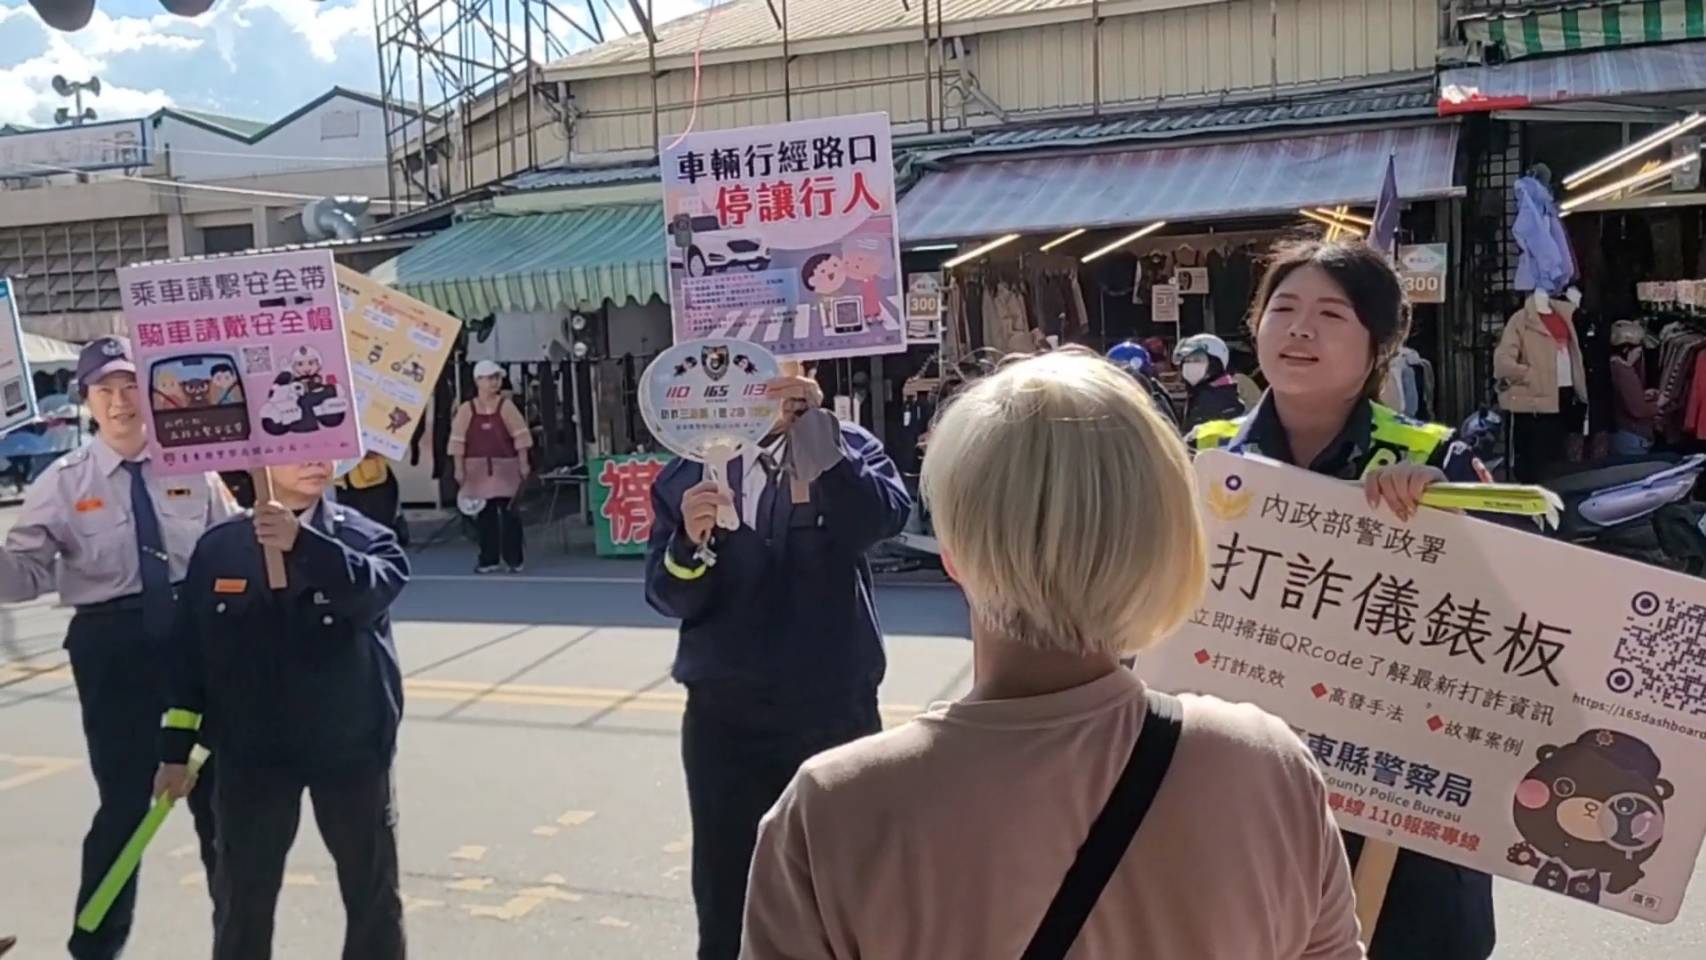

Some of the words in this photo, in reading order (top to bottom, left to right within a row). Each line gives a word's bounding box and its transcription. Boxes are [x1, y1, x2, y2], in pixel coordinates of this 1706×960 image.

[677, 134, 877, 184] 車輛行經路口
[715, 172, 881, 226] 停讓行人
[130, 265, 326, 308] 乘車請繫安全帶
[911, 297, 937, 312] 300
[137, 307, 334, 348] 騎車請戴安全帽
[666, 386, 691, 399] 110
[703, 384, 730, 398] 165
[743, 383, 768, 396] 113
[1260, 493, 1447, 565] 內政部警政署
[1210, 531, 1572, 687] 打詐儀錶板
[1188, 607, 1555, 727] 立即掃描QRcode了解最新打詐資訊
[1211, 652, 1286, 689] 打詐成效
[1328, 686, 1404, 723] 高發手法
[1445, 720, 1524, 757] 故事案例
[1290, 724, 1473, 808] 東縣警察局
[1369, 786, 1410, 808] Police
[1413, 800, 1463, 824] Bureau
[1368, 805, 1481, 853] 110報案專線
